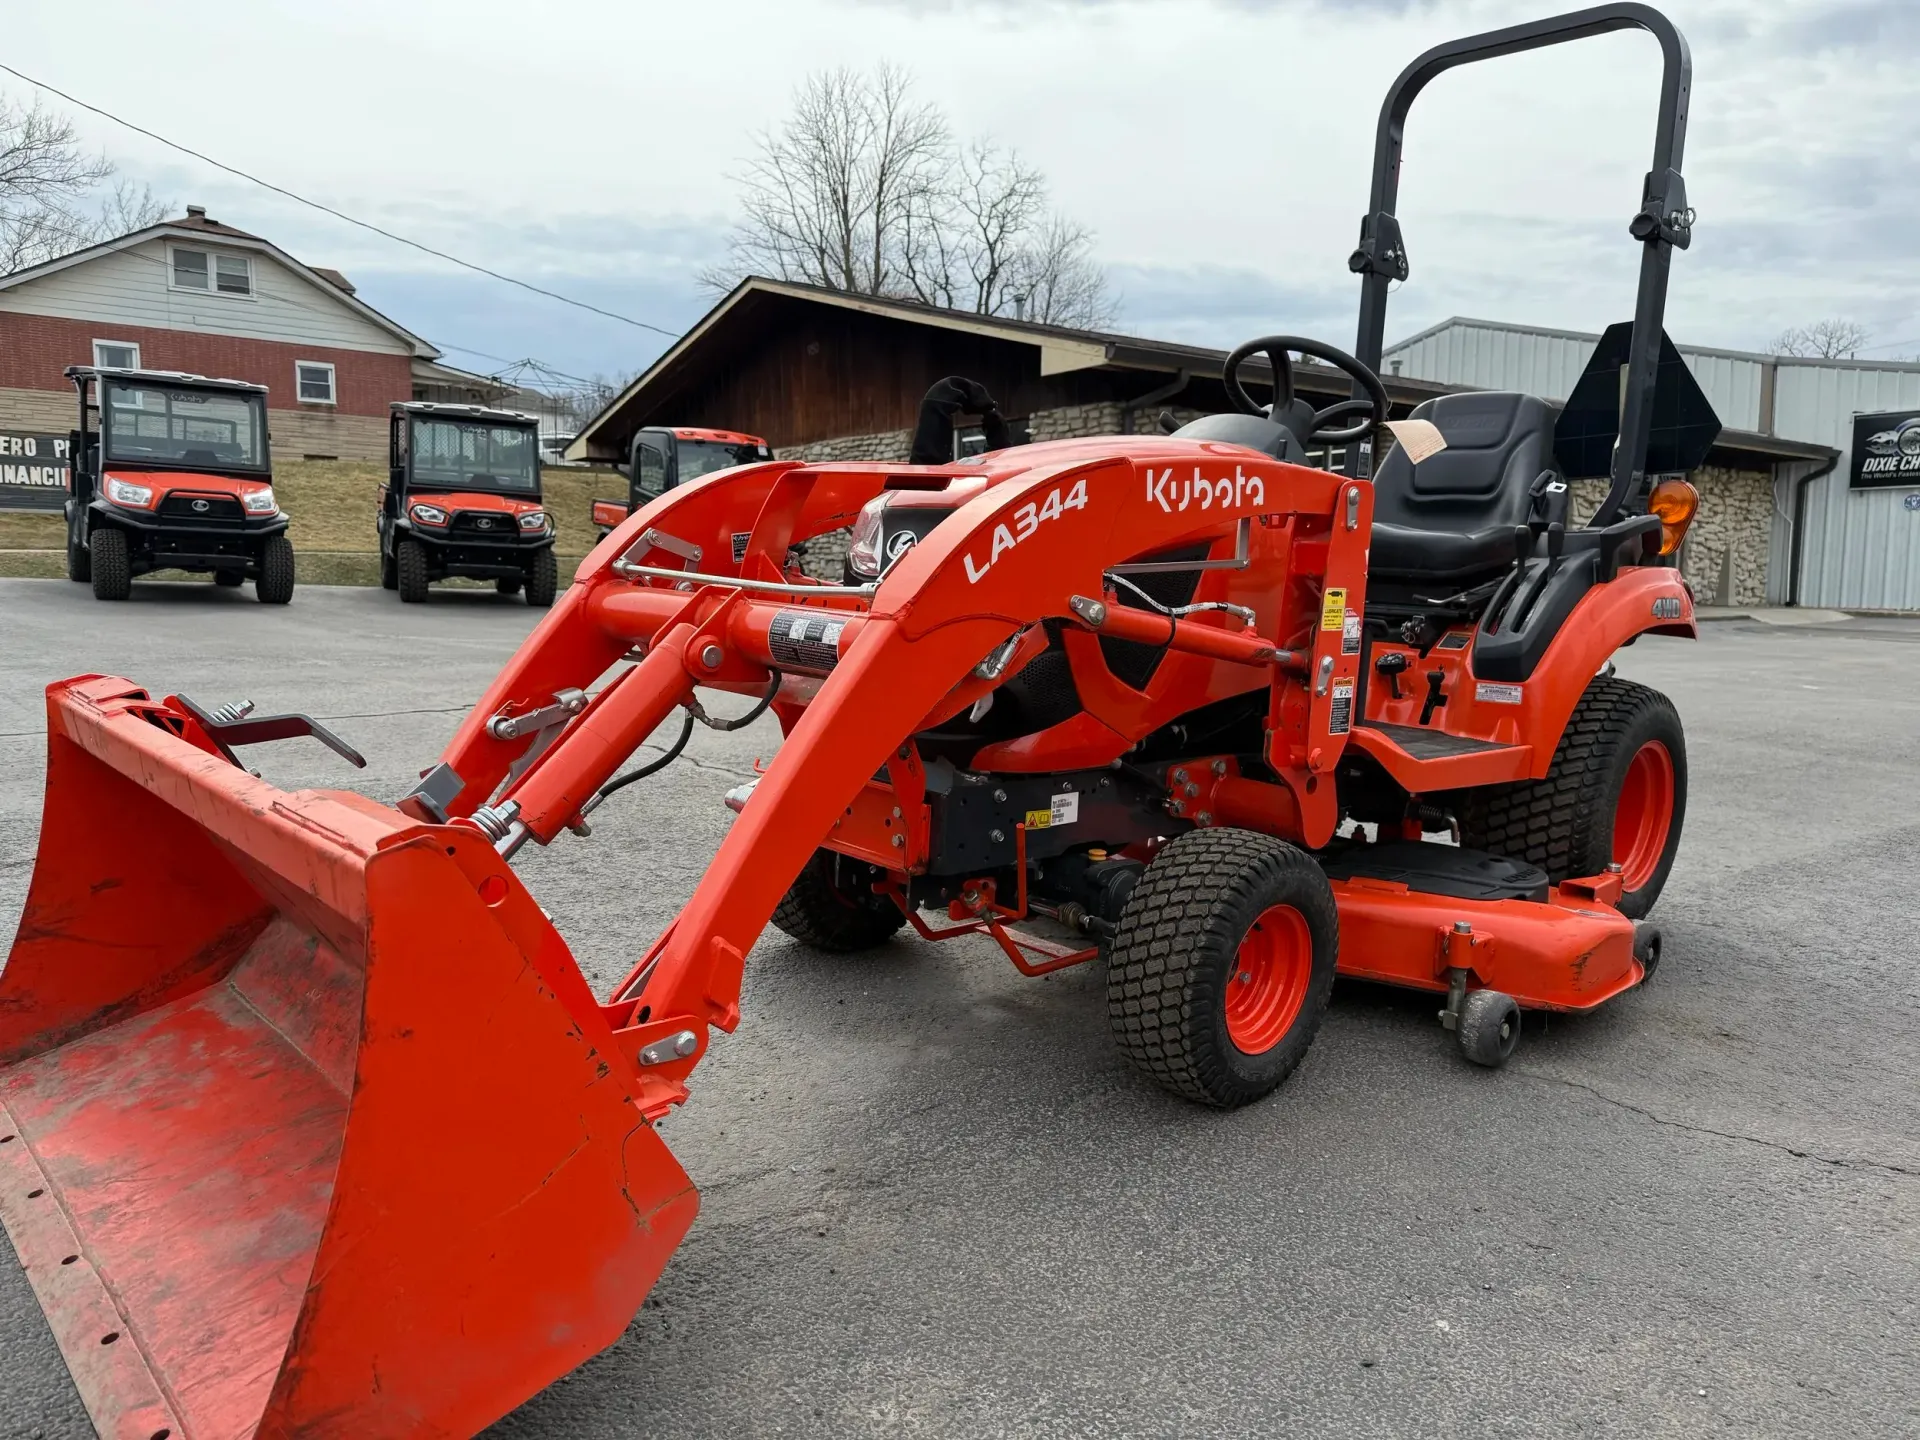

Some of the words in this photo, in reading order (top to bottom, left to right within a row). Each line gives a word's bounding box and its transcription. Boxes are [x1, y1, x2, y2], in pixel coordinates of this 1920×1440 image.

[1862, 456, 1900, 473] DIXIE
[1146, 465, 1264, 513] Kubota
[963, 479, 1088, 584] LA344
[1652, 597, 1681, 620] 4WD
